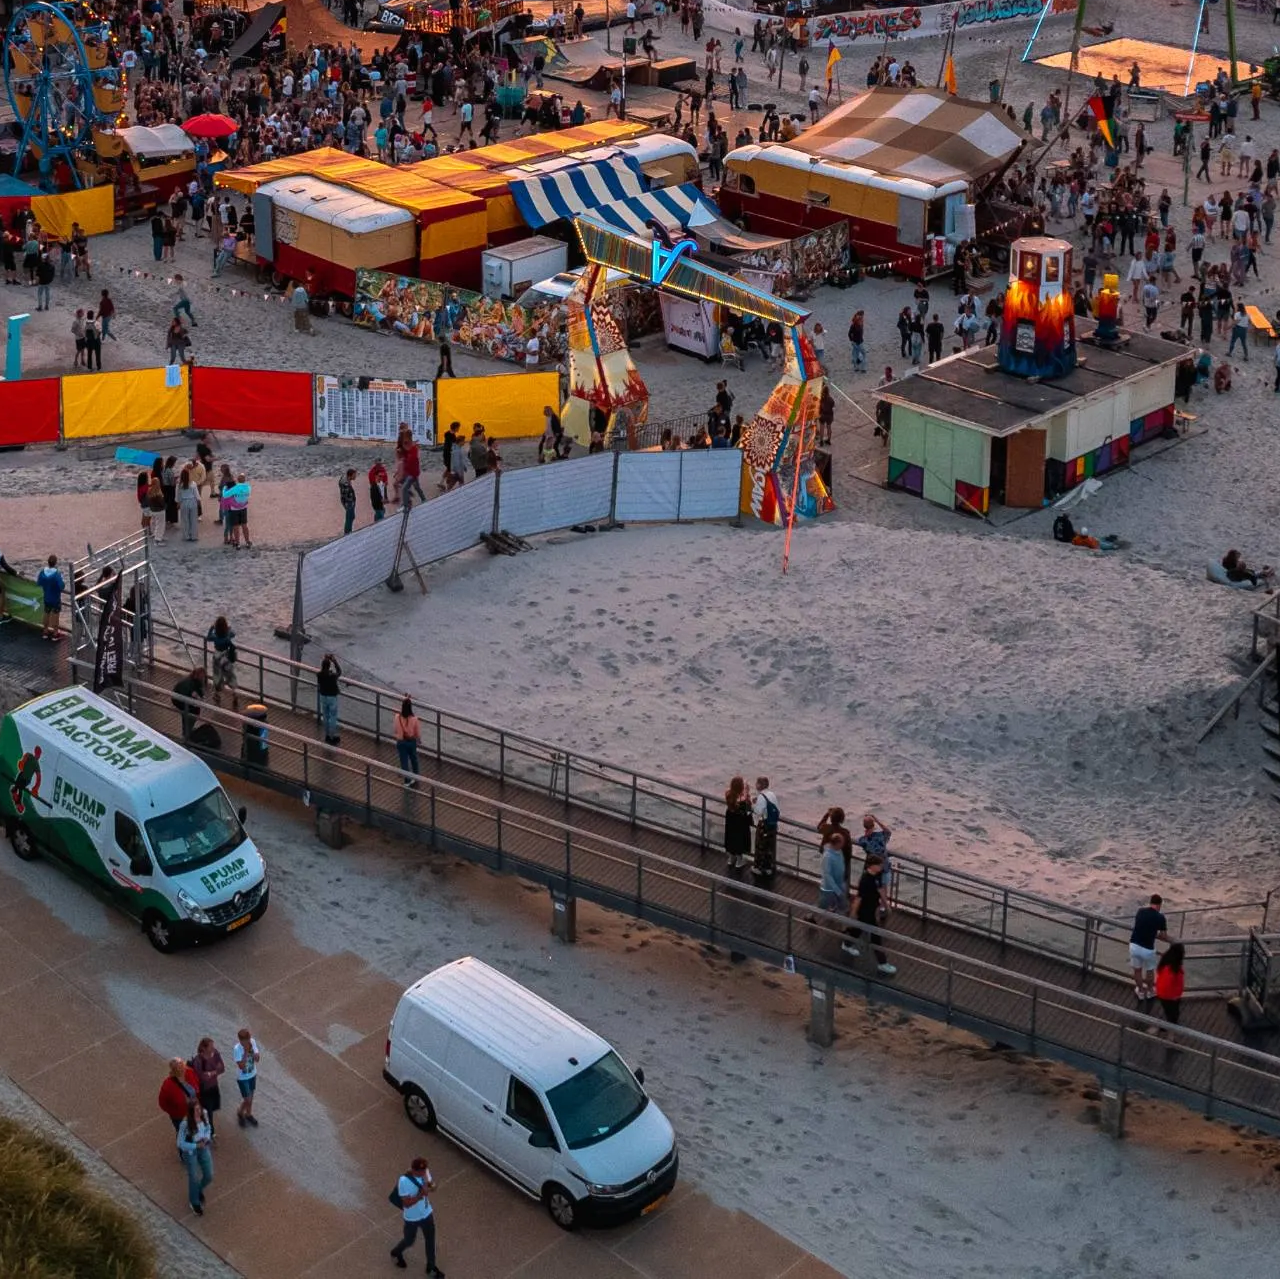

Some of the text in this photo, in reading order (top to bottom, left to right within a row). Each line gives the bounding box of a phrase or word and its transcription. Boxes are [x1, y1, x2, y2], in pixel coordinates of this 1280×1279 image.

[35, 696, 83, 719] THE
[49, 718, 139, 770] FACTORY
[67, 704, 172, 762] PUMP
[61, 799, 102, 830] FACTORY
[63, 782, 106, 818] PUMP
[208, 858, 246, 883] PUMP
[216, 868, 250, 890] FACTORY
